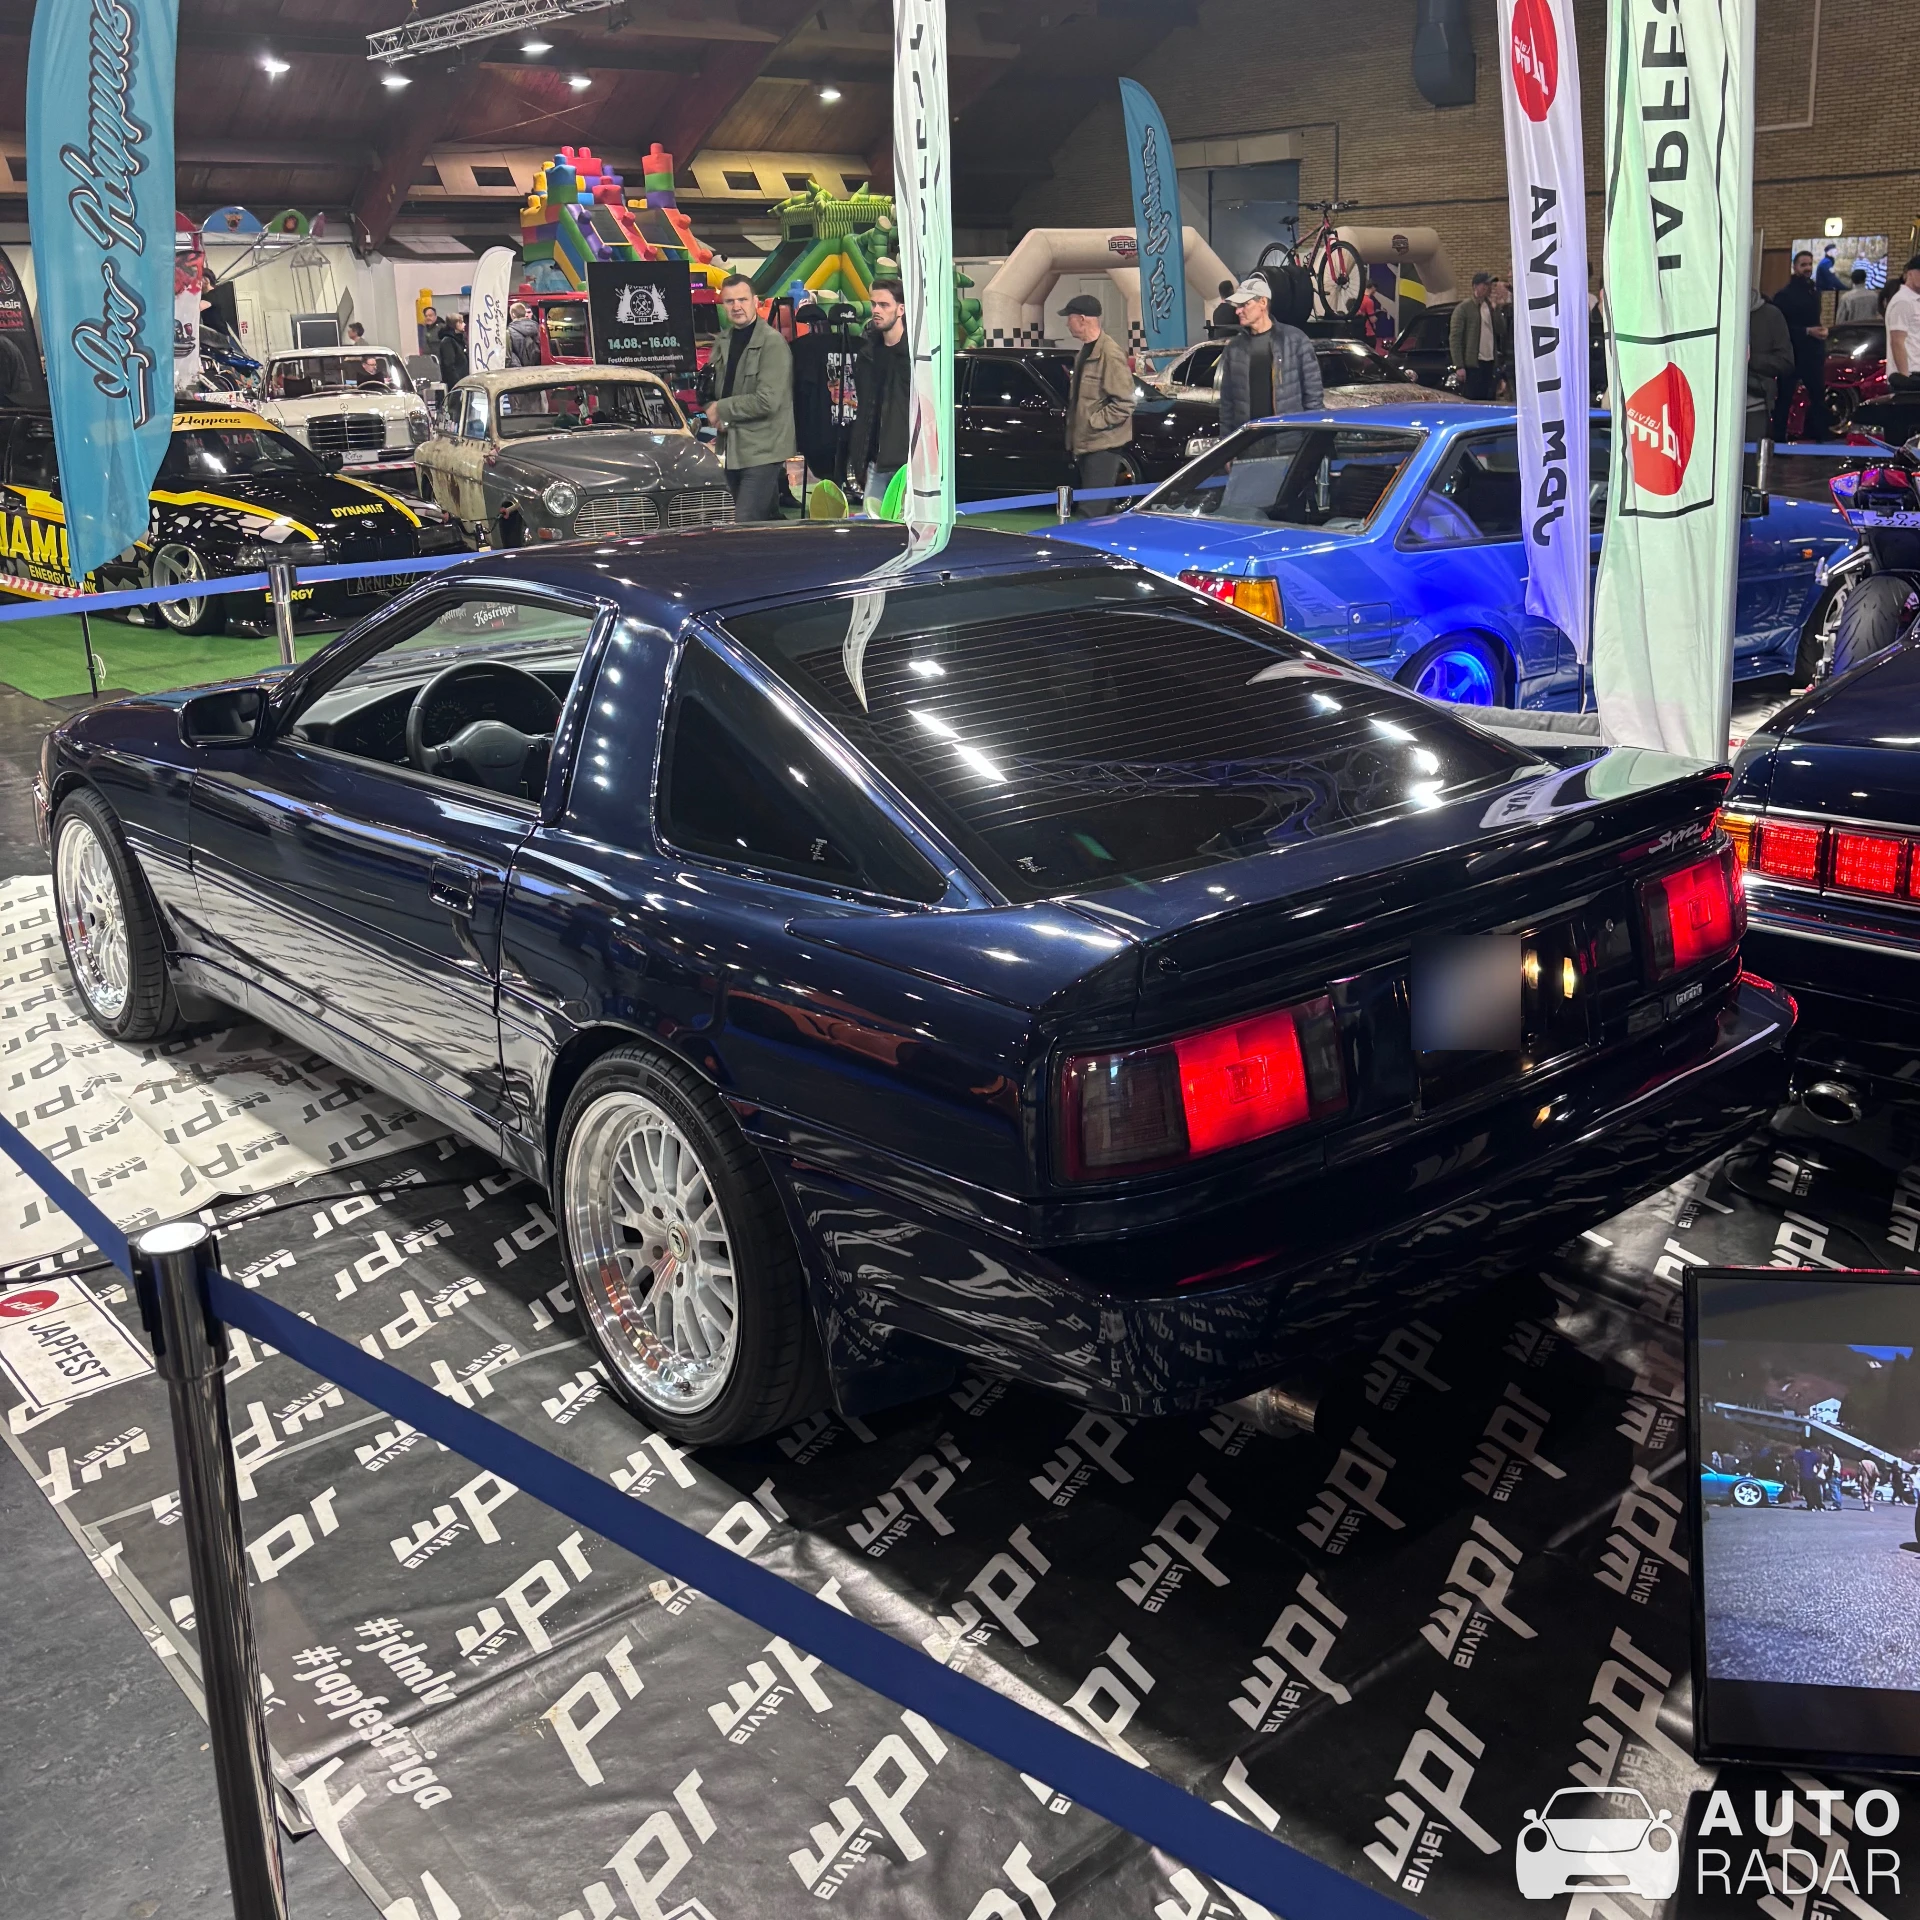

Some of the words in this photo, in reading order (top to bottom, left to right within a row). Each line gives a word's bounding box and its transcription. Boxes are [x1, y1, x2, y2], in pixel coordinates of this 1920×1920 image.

[1110, 240, 1136, 249] BERG
[28, 565, 65, 585] ENERGY
[265, 588, 314, 602] ERGY
[90, 1156, 142, 1181] Latvia
[395, 1218, 446, 1244] Latvia
[234, 1248, 290, 1278] Latvia
[424, 1276, 478, 1305] Latvia
[27, 1320, 112, 1385] JAPFEST
[456, 1342, 514, 1377] Latvia
[273, 1381, 337, 1419] Latvia
[555, 1384, 610, 1425] Latvia
[73, 1426, 144, 1467] Latvia
[1053, 1464, 1098, 1507] Latvia
[1492, 1459, 1528, 1502] Latvia
[402, 1522, 471, 1569] Latvia
[867, 1513, 920, 1557] Latvia
[1325, 1508, 1368, 1555] Latvia
[1143, 1563, 1192, 1613] Latvia
[1630, 1555, 1665, 1605] Latvia
[354, 1617, 458, 1705] #jdmlv
[1453, 1611, 1496, 1669] Latvia
[291, 1645, 453, 1810] #japfestriga
[729, 1684, 795, 1745] Latvia
[1261, 1680, 1310, 1733] Latvia
[813, 1827, 884, 1900] Latvia
[1402, 1821, 1452, 1893] Latvia
